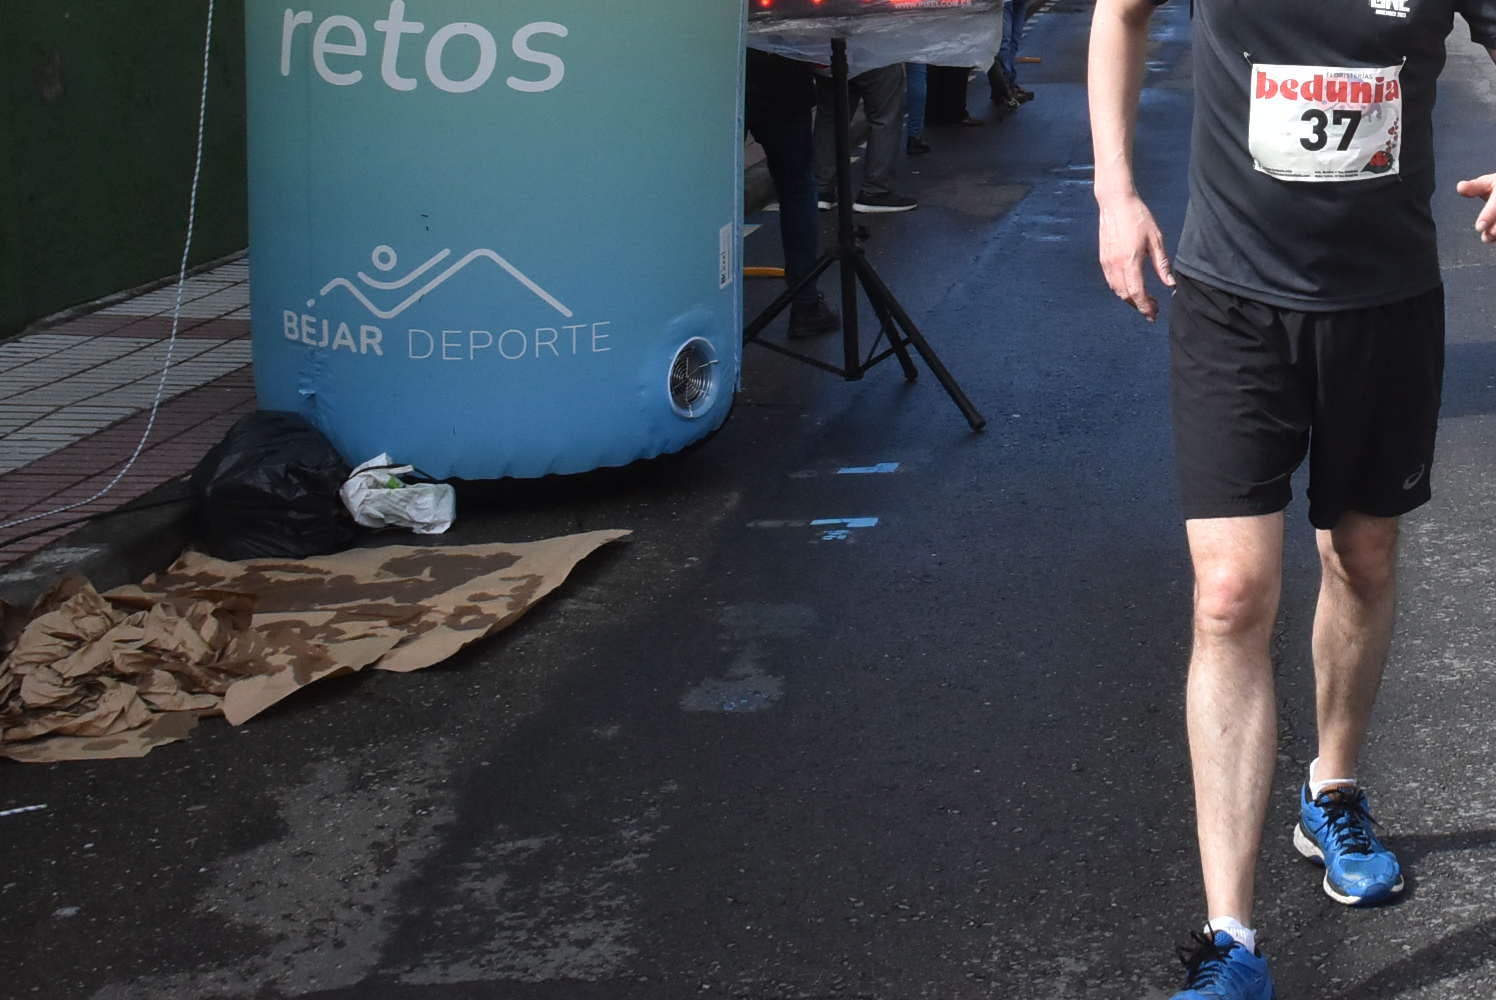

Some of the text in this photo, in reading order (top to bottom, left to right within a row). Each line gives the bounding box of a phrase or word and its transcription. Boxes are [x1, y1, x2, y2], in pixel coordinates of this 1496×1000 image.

[280, 0, 569, 93] retos
[1255, 71, 1400, 104] bedunia
[1299, 109, 1363, 152] 37
[407, 320, 613, 361] DEPORTE
